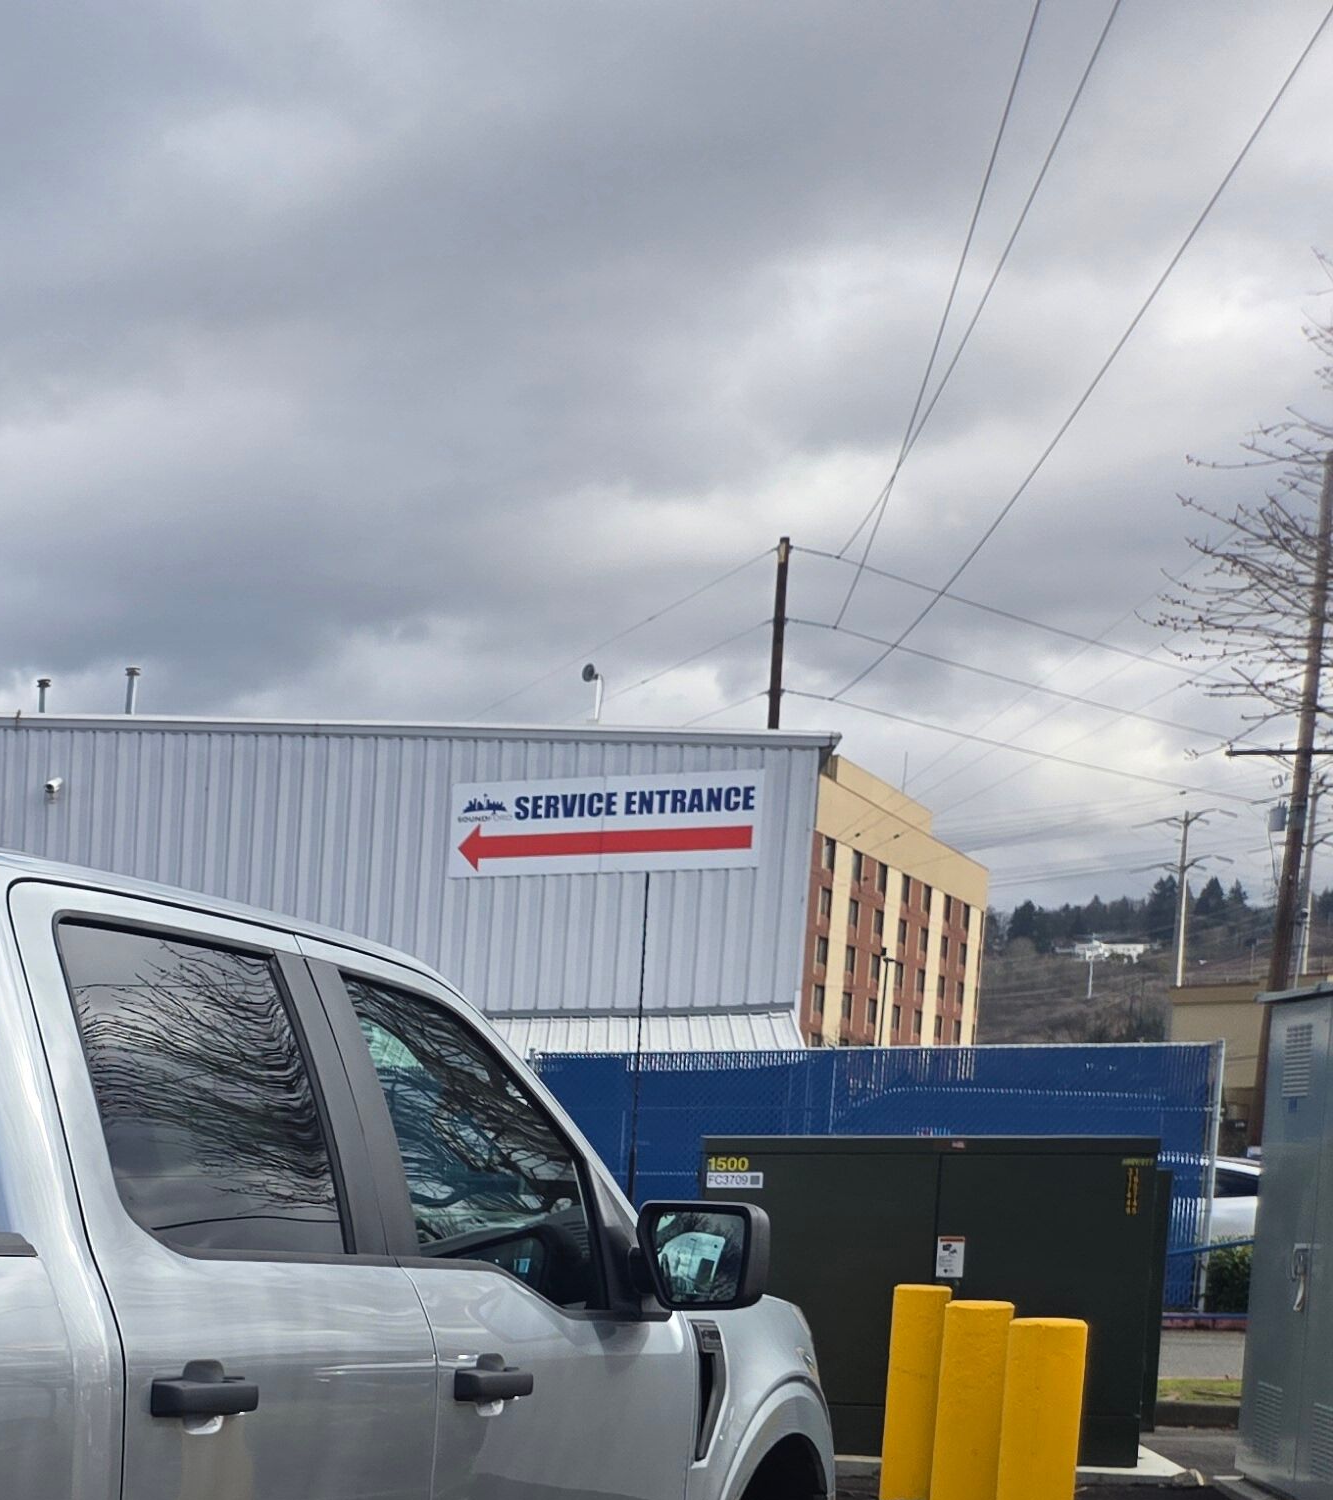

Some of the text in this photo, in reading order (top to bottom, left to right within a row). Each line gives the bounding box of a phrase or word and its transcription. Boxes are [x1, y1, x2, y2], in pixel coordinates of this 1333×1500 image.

[514, 786, 756, 821] SERVICE ENTRANCE
[708, 1157, 749, 1171] 1500
[708, 1174, 749, 1186] FC3709
